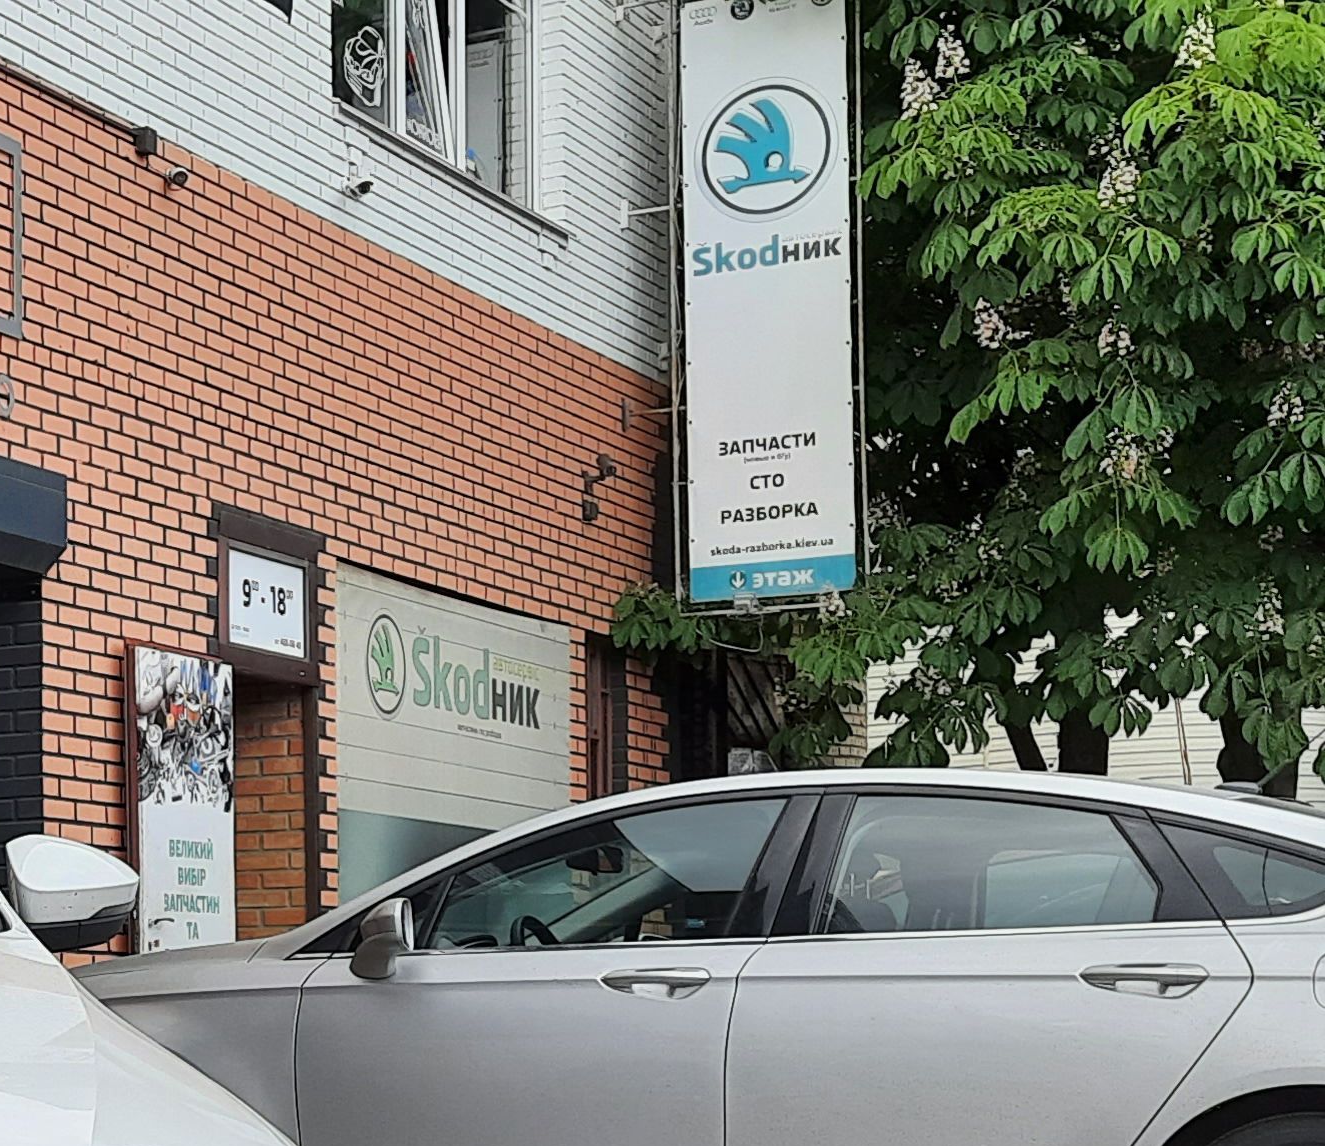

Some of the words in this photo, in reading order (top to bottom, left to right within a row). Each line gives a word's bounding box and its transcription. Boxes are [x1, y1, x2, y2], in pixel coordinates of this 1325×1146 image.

[718, 432, 816, 456] ЗАПЧАСТИ
[750, 473, 784, 489] СТО
[720, 502, 819, 524] РАЗБОРКА
[710, 537, 834, 556] skoda-razborka.kiev.ua
[752, 568, 814, 588] этаж
[169, 838, 213, 860] ВЕЛИКИЙ
[177, 866, 206, 886] ВИБІР
[163, 893, 220, 914] ЗАПЧАСТИН
[186, 921, 199, 940] ТА
